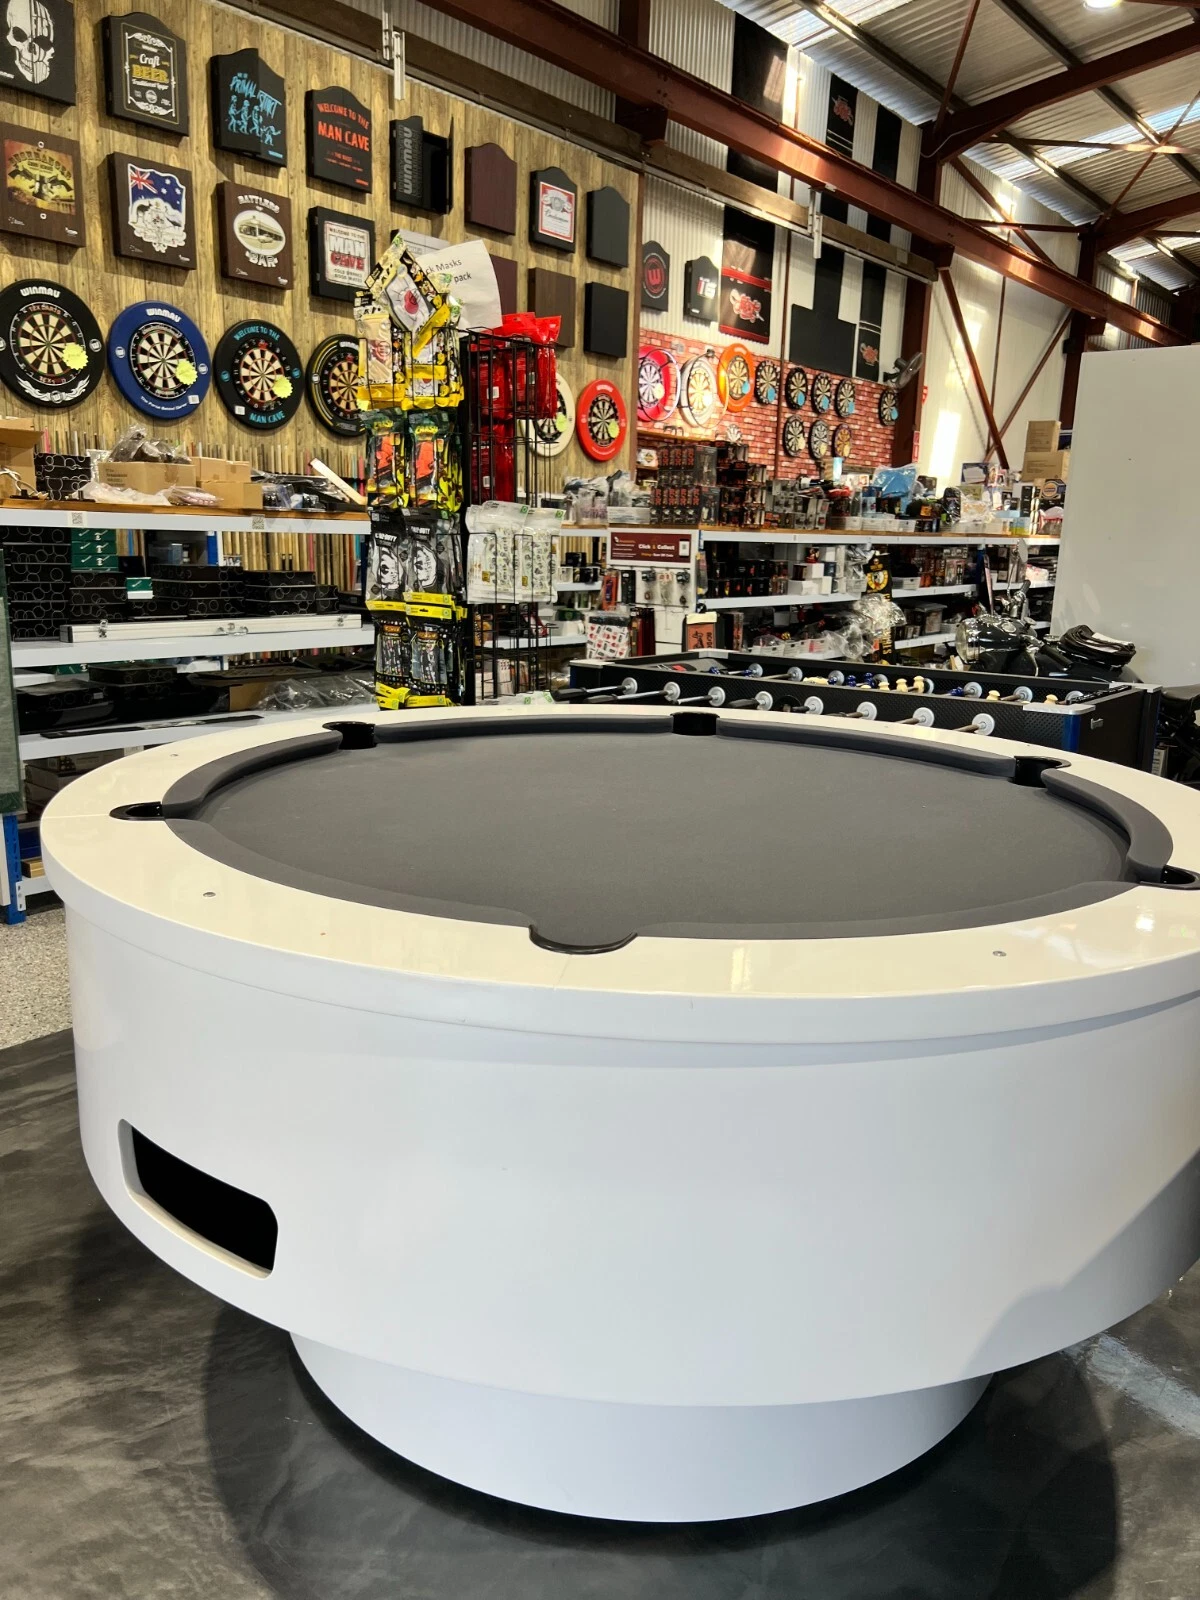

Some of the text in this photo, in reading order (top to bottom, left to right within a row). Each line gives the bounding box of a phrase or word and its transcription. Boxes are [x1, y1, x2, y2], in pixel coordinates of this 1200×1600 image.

[140, 54, 160, 68] Craft
[132, 64, 169, 84] BEER
[317, 103, 369, 129] WELCOME TO THE
[318, 121, 369, 151] MAN CAVE
[329, 234, 366, 259] MAN
[249, 254, 276, 268] BAR
[331, 252, 364, 271] CAVE
[436, 259, 462, 271] Masks
[453, 272, 472, 284] pack
[234, 326, 280, 340] WELCOME TO THE
[249, 410, 286, 423] MAN CAVE
